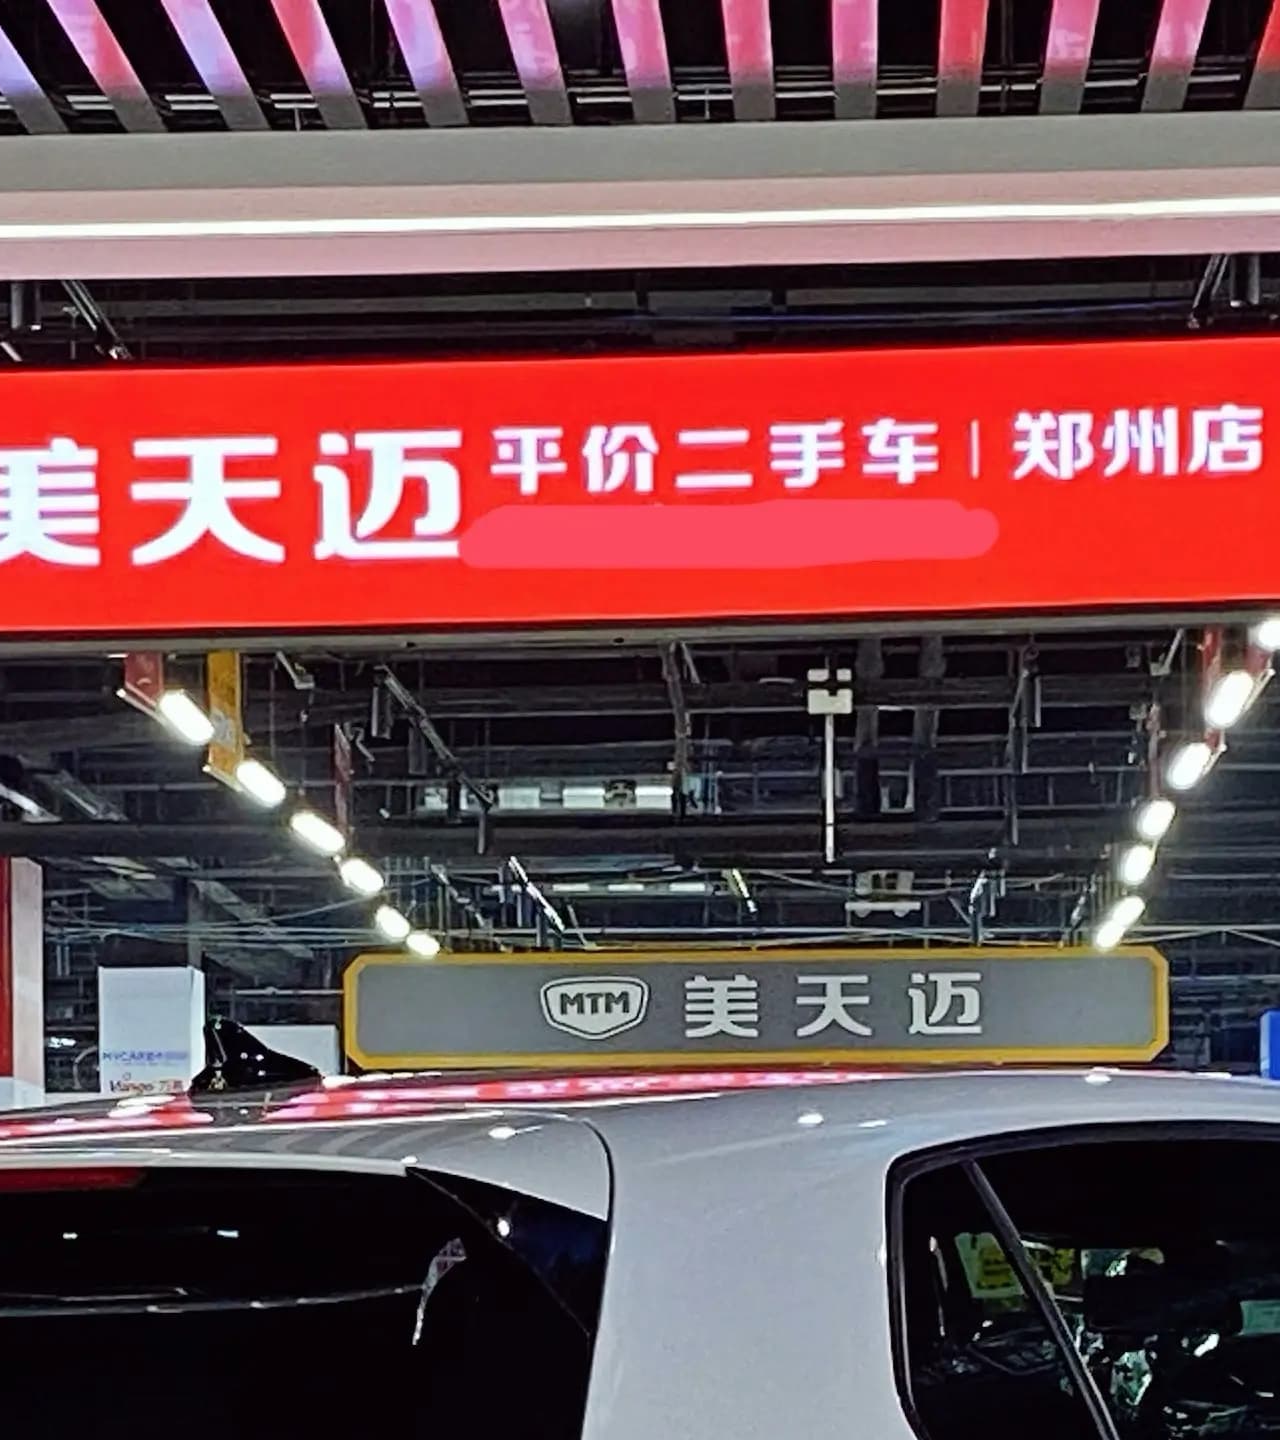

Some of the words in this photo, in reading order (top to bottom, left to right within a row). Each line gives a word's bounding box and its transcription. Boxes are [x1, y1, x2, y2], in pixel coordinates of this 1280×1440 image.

[490, 420, 941, 497] 平价二手车
[1011, 404, 1264, 482] 郑州店
[559, 991, 631, 1018] MTM
[683, 972, 983, 1038] 美天迈
